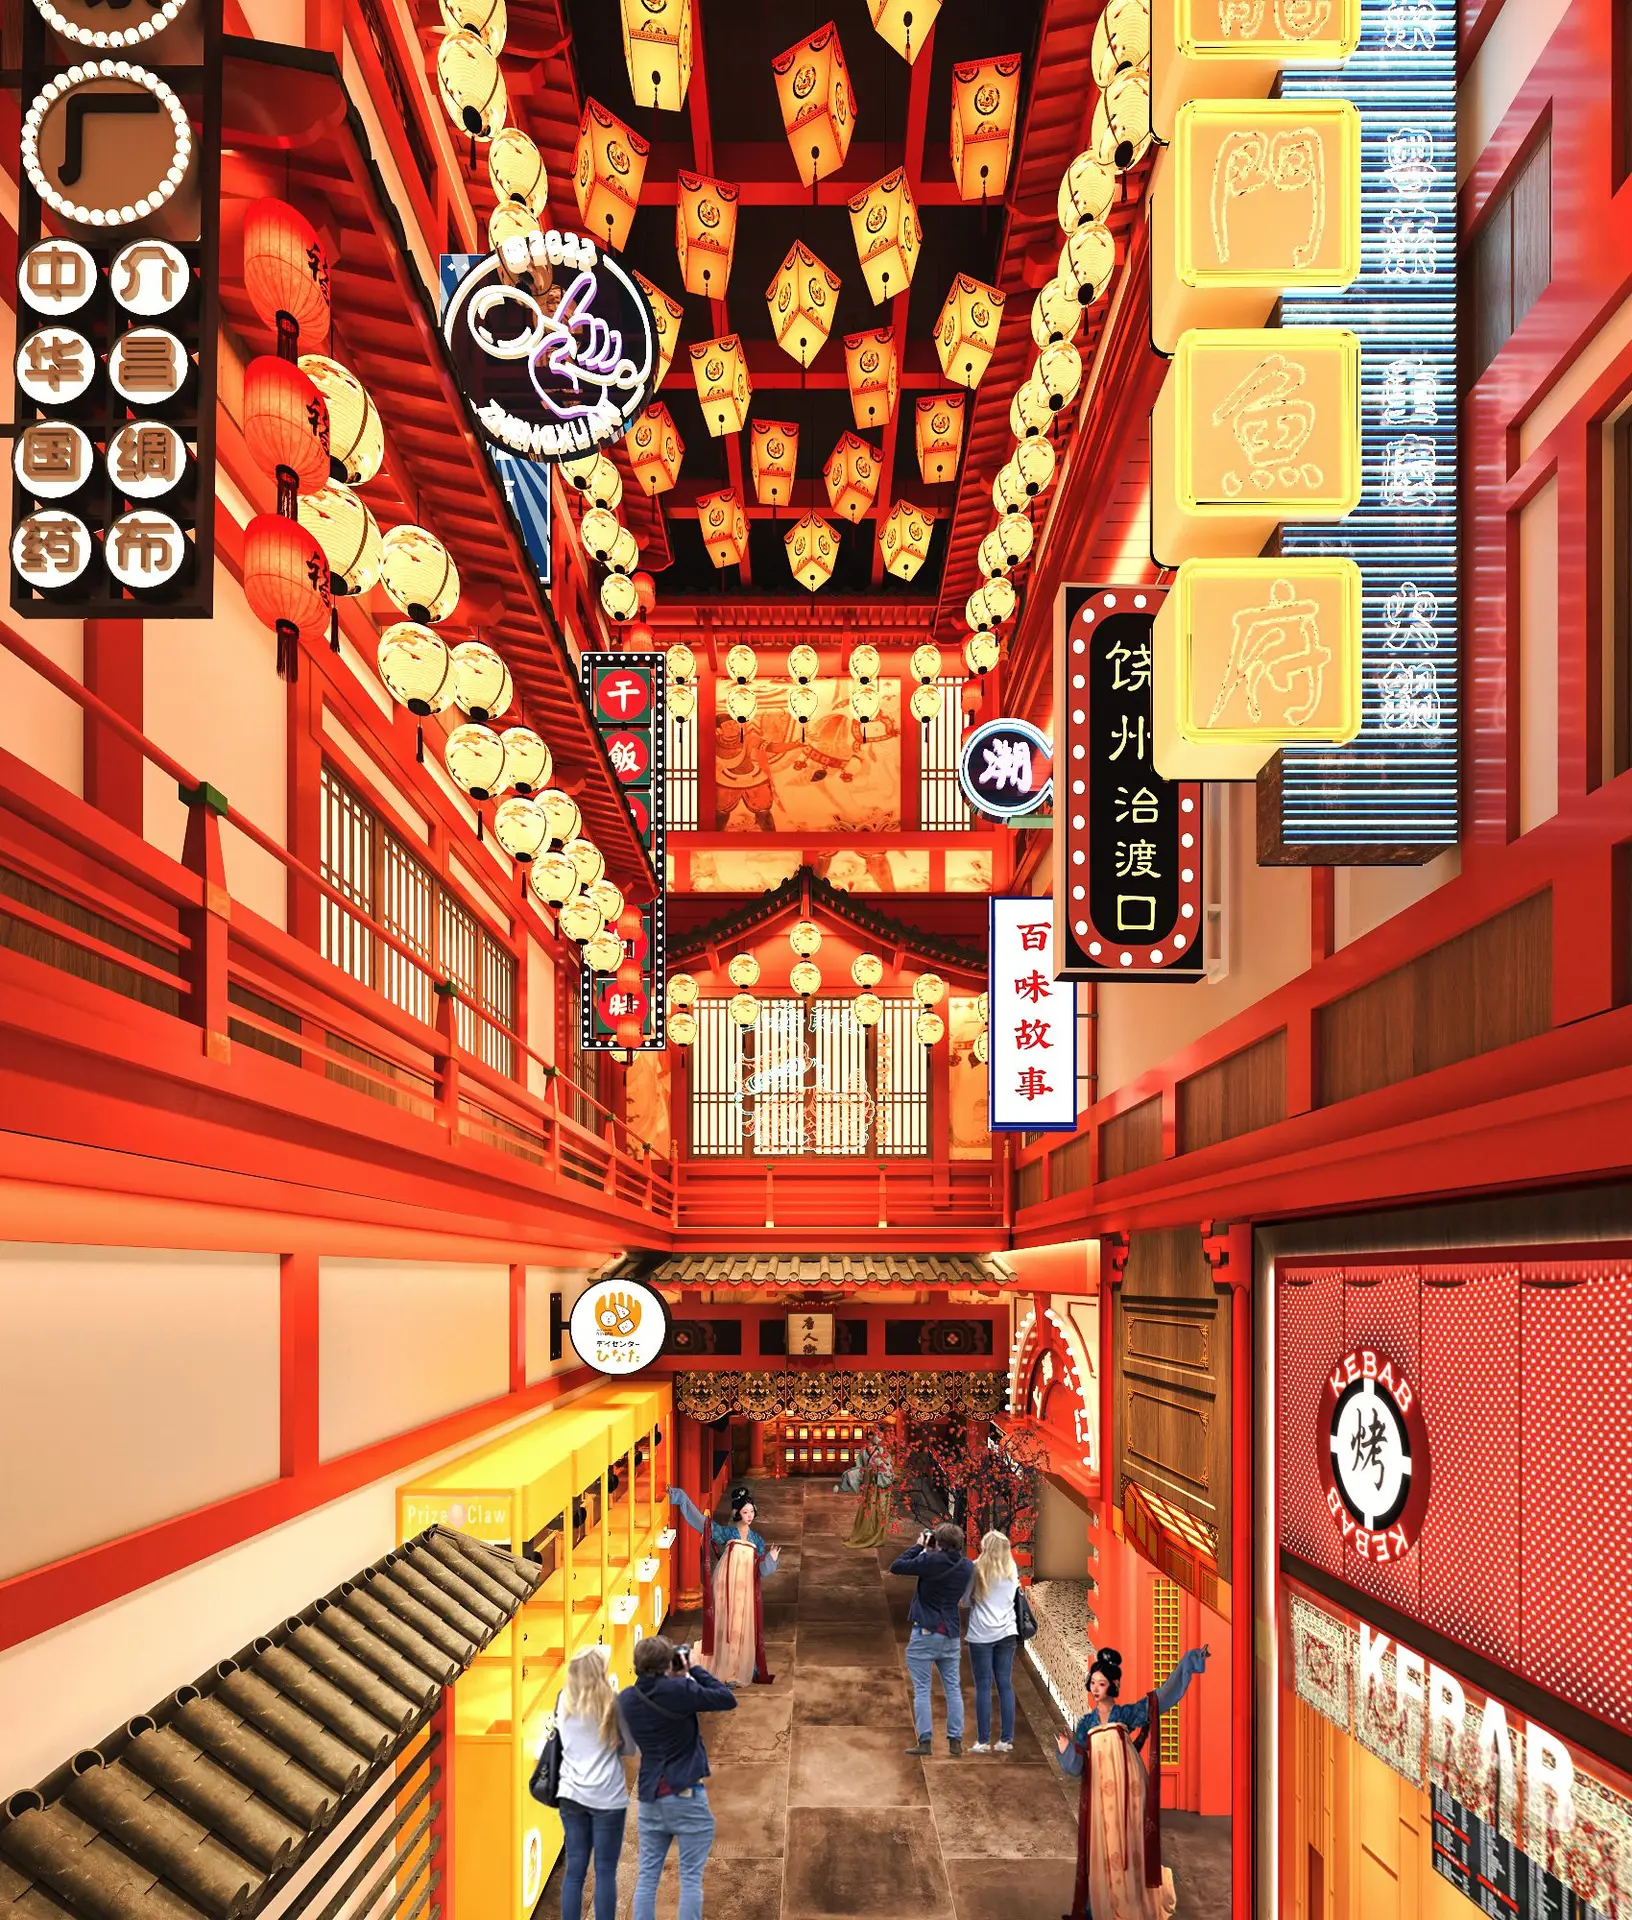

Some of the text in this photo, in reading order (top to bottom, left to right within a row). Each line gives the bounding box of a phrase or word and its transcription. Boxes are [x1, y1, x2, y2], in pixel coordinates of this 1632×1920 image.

[20, 246, 86, 572] 中华国药
[116, 247, 179, 572] 介昌绸布
[1015, 922, 1054, 1100] 百味故事
[596, 1349, 640, 1363] ひなた
[1328, 1350, 1413, 1413] KEBAB
[1350, 1407, 1388, 1491] 烤
[407, 1504, 506, 1524] Prize Claw
[1327, 1486, 1410, 1562] KEBAB
